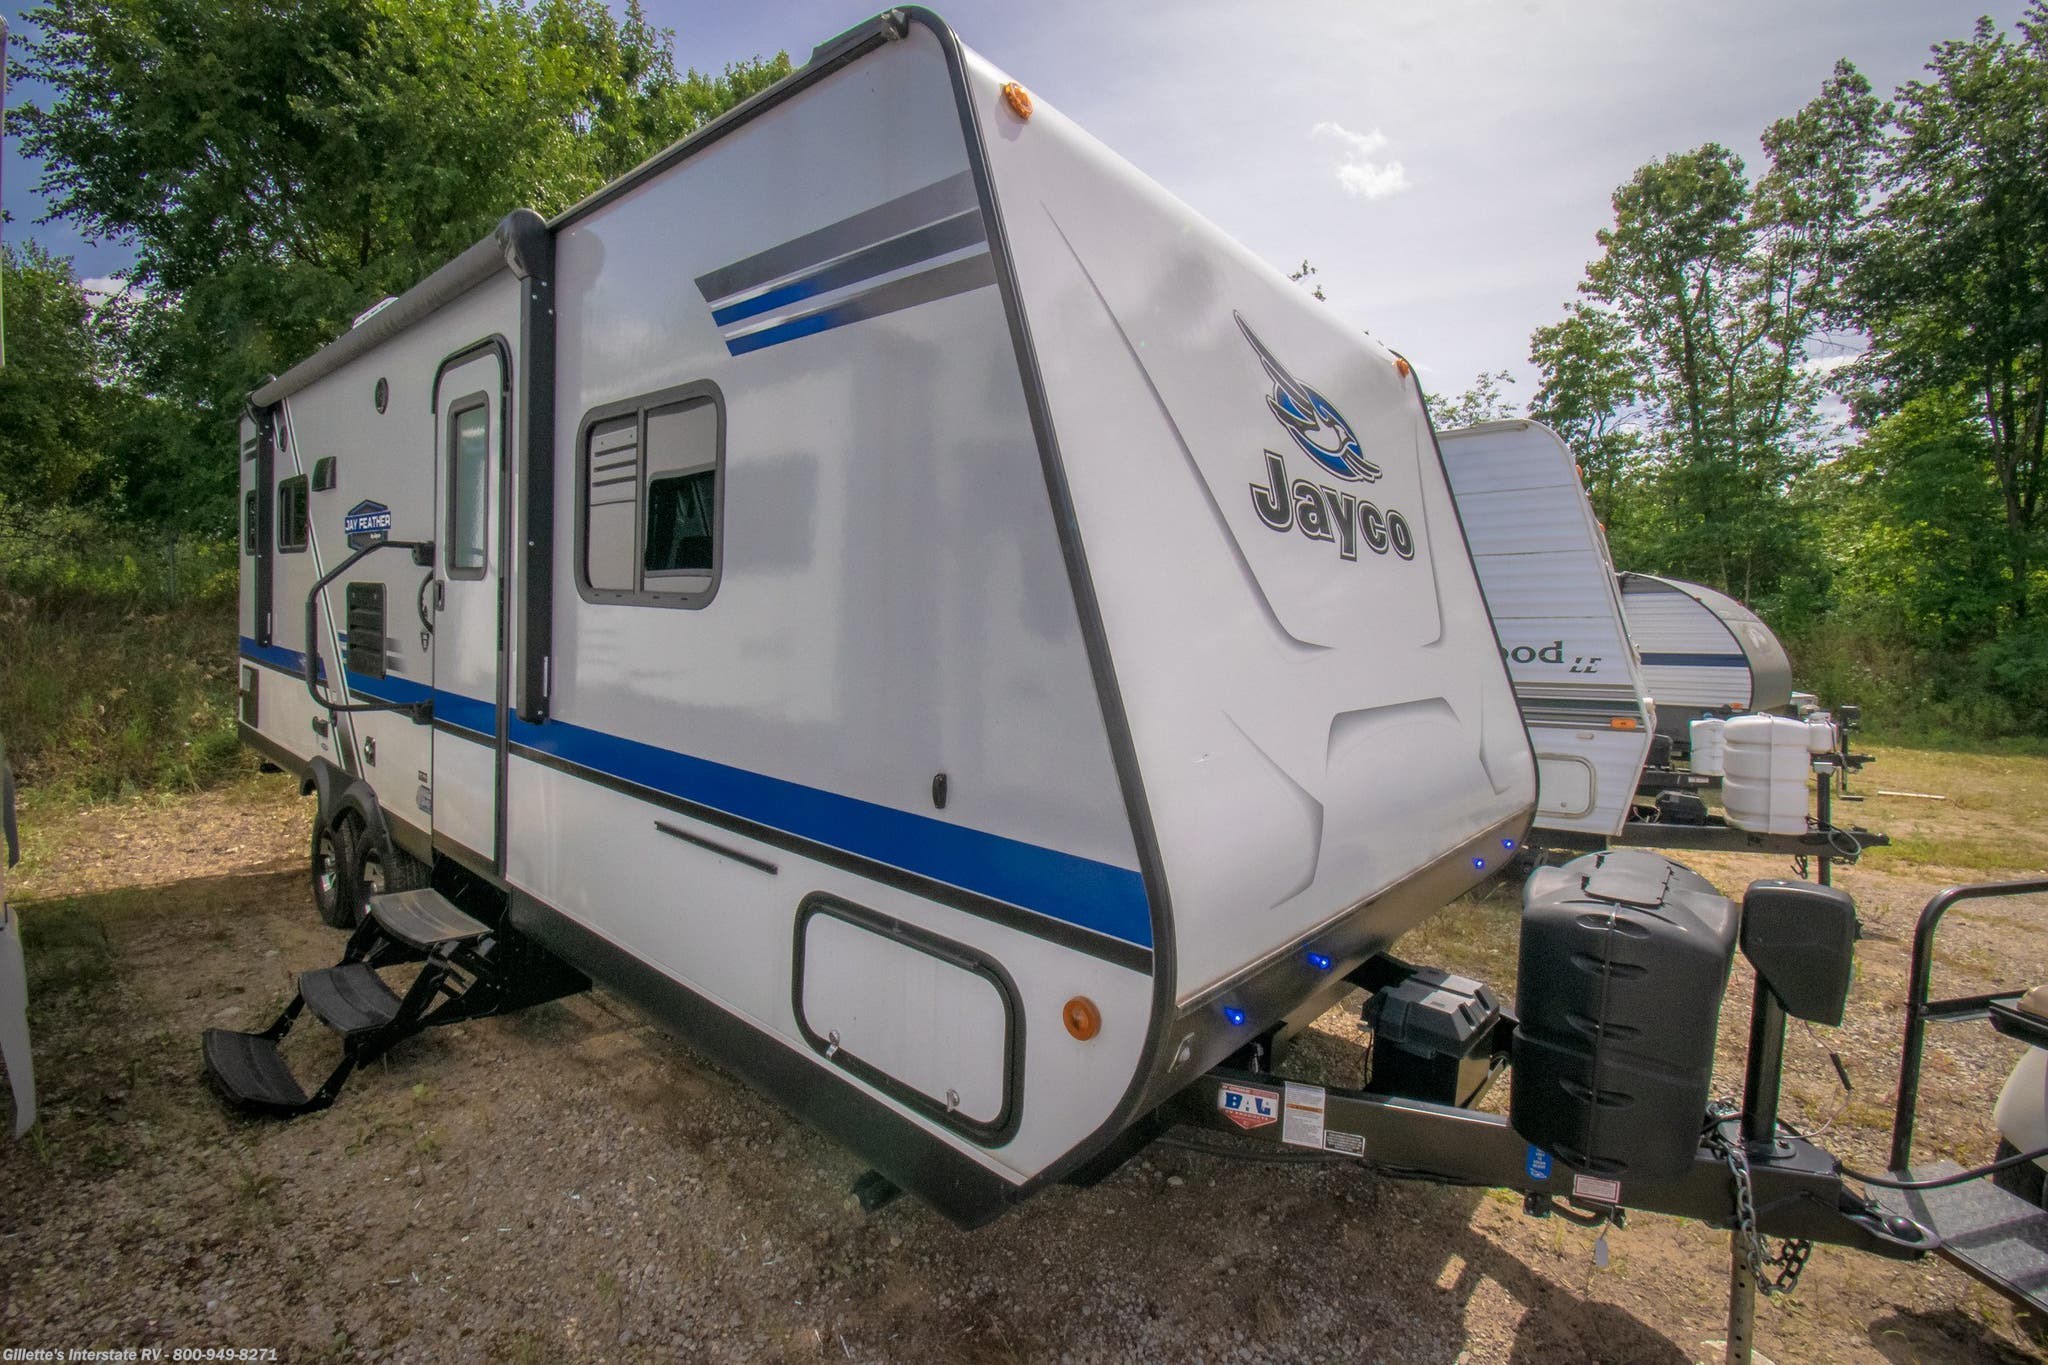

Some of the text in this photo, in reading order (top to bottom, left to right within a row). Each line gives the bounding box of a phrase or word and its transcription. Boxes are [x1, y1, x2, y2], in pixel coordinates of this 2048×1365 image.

[345, 514, 391, 531] JAY FEATHER
[1249, 448, 1415, 562] Jayco
